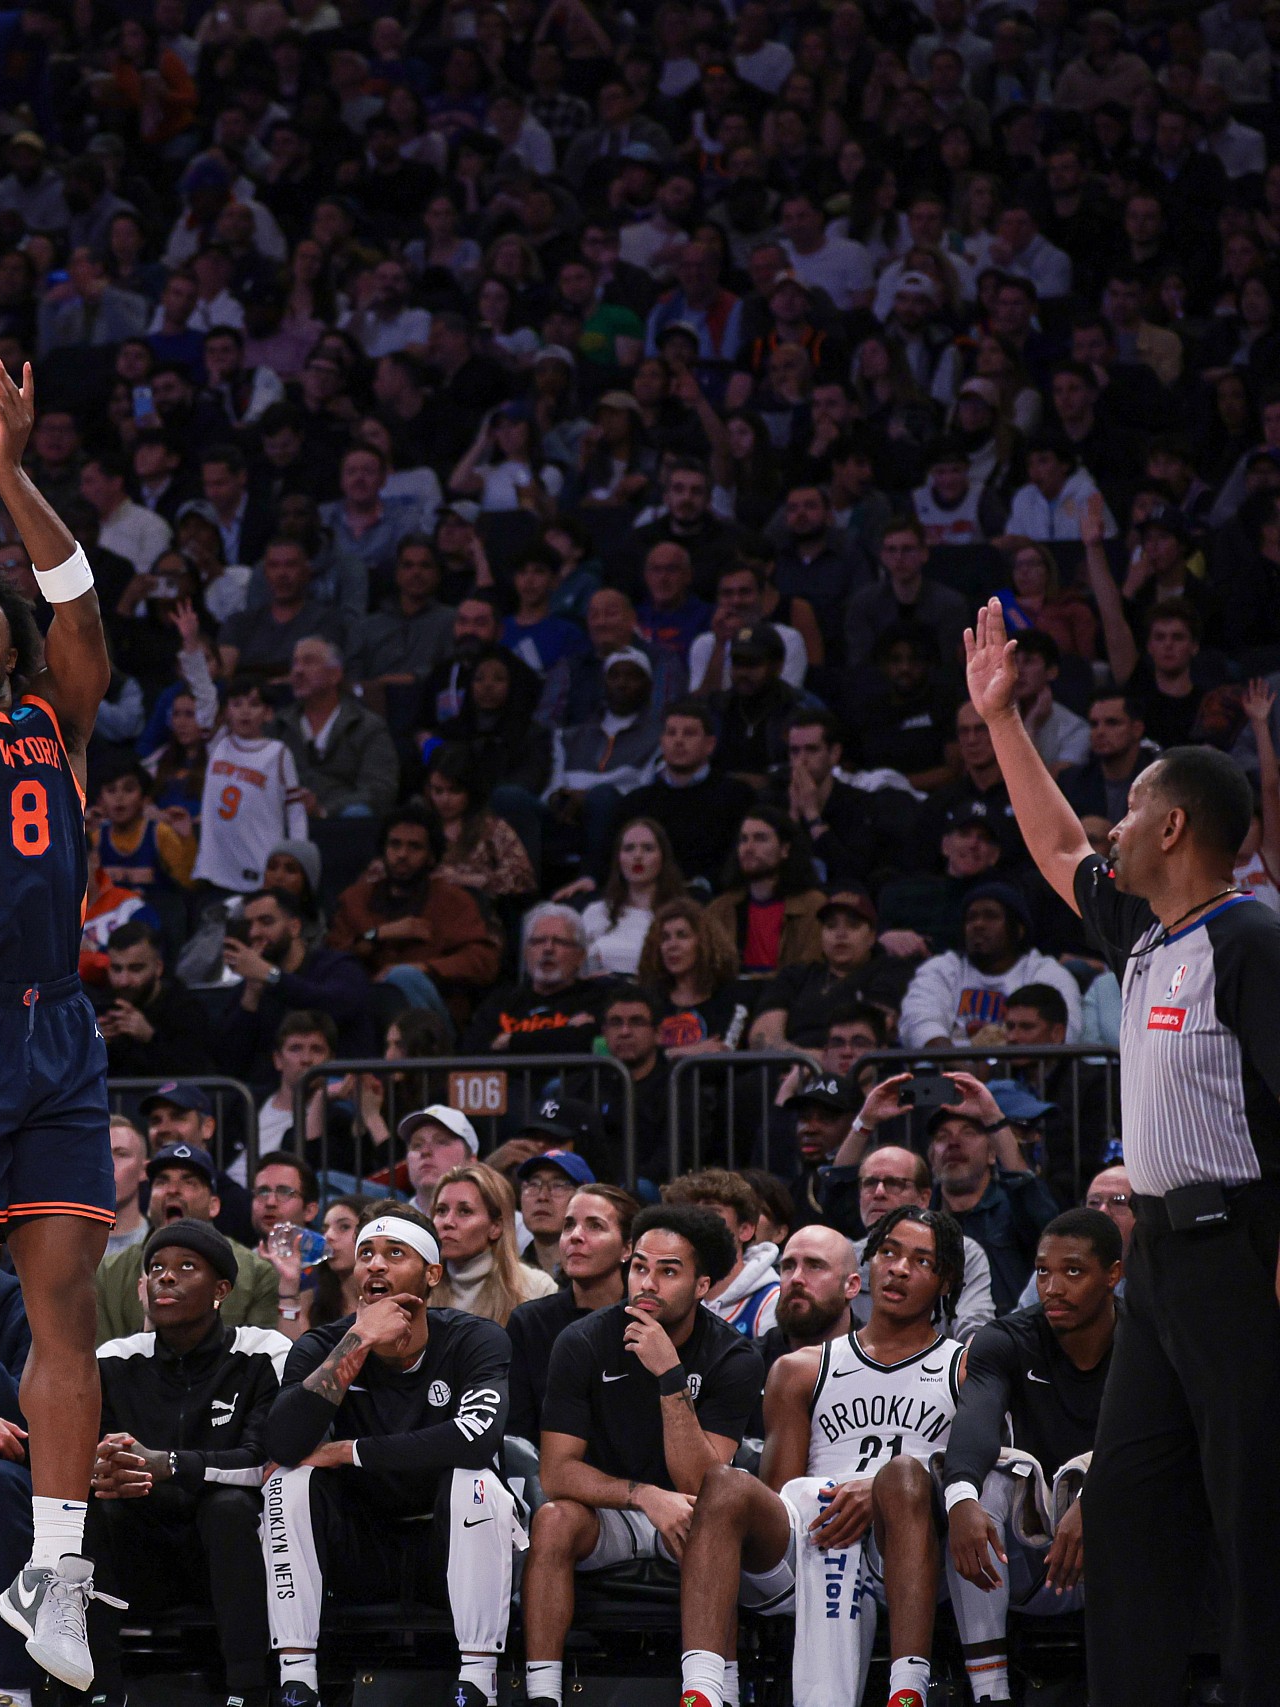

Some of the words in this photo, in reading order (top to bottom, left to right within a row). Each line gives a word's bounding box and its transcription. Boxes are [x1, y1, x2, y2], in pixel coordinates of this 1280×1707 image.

[10, 779, 51, 857] 8
[217, 786, 241, 821] 9
[1149, 1012, 1179, 1026] Emirates
[455, 1077, 501, 1110] 106
[453, 1388, 501, 1442] NETS
[818, 1395, 952, 1443] BROOKLYN
[855, 1435, 903, 1473] 21
[268, 1477, 289, 1554] BROOKLYN
[274, 1562, 295, 1601] NETS
